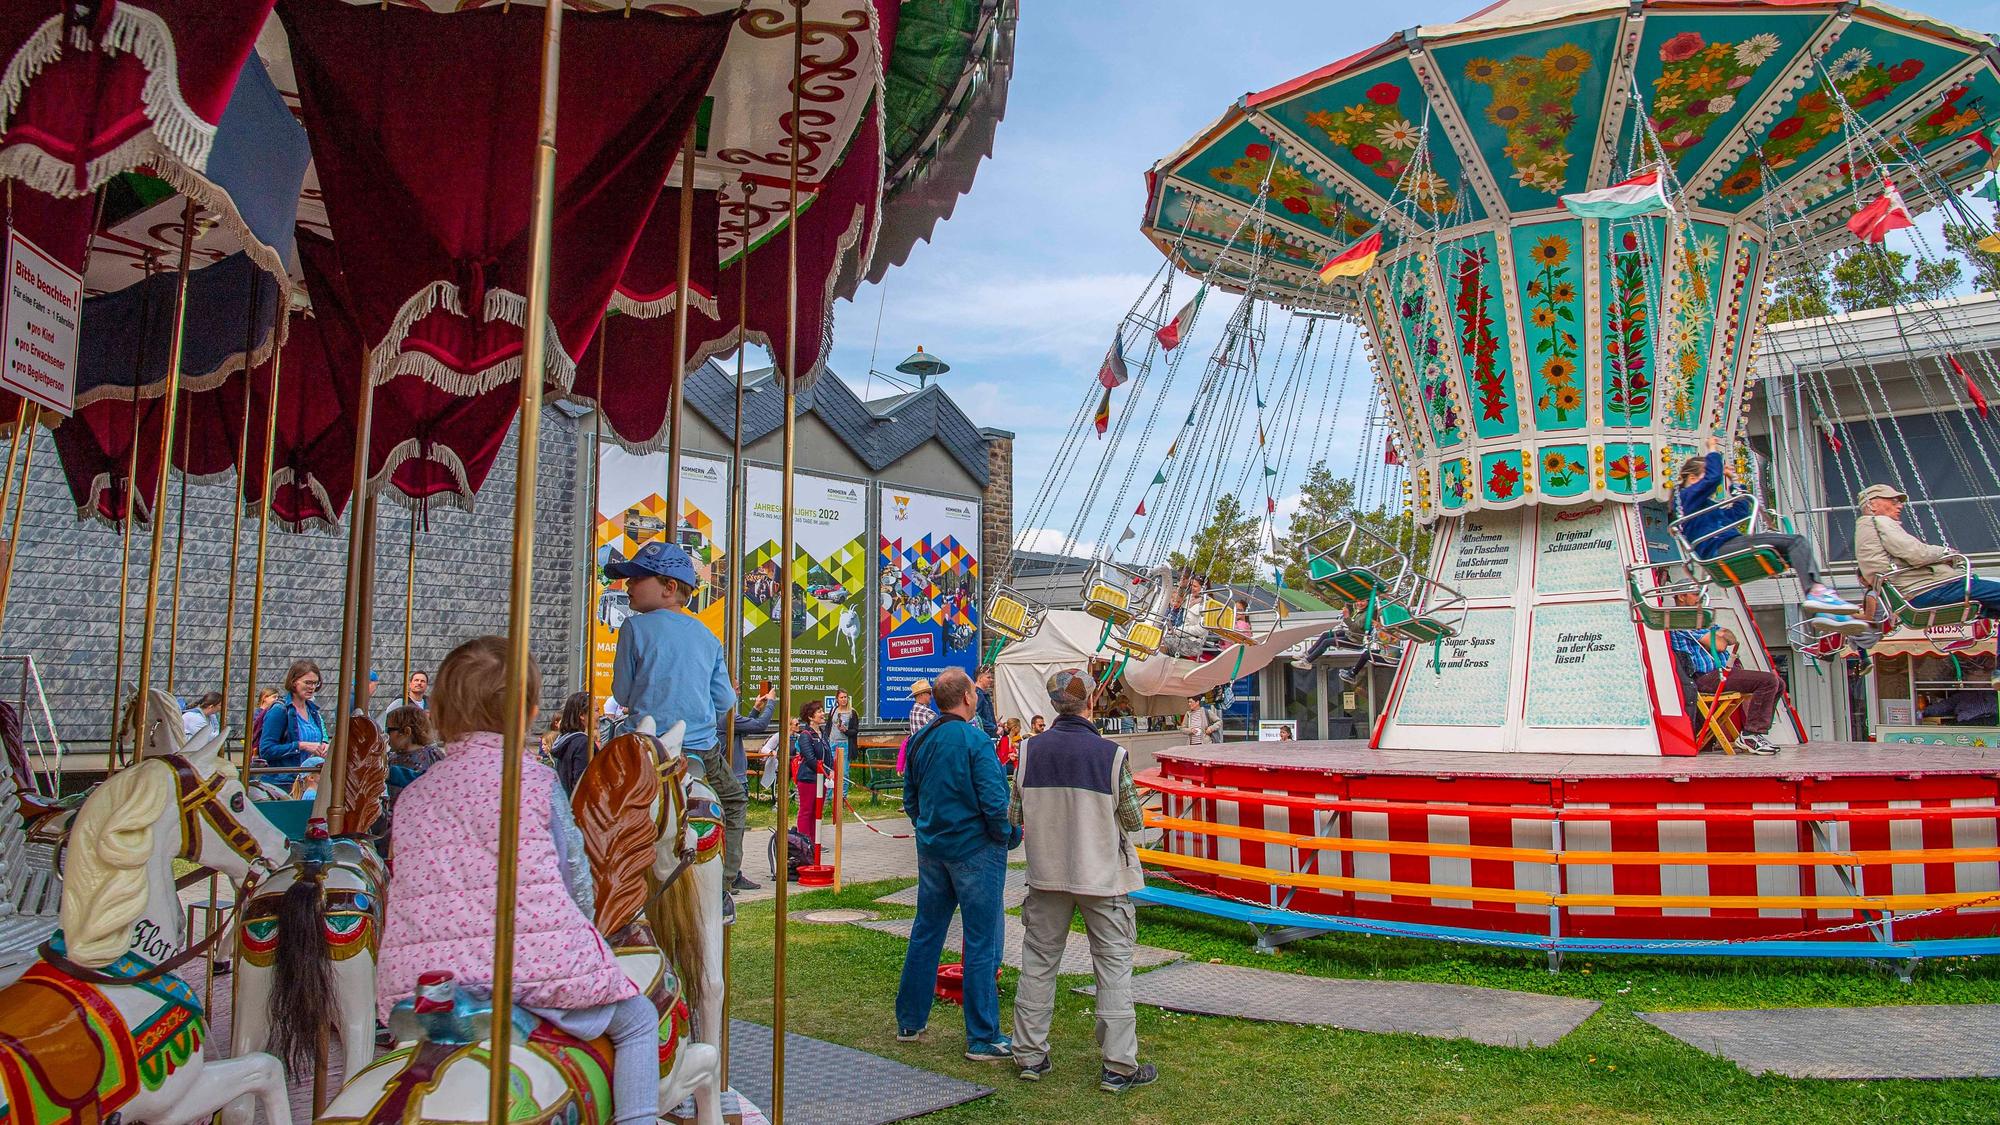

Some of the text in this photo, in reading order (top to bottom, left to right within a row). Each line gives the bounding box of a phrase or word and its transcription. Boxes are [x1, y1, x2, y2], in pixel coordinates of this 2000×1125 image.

[15, 259, 36, 286] Bitte
[36, 273, 72, 309] beachten
[31, 323, 55, 344] pro Kind
[19, 339, 66, 371] pro Erwachsener
[16, 361, 65, 392] pro Begleitperson
[818, 508, 839, 521] 2022
[1468, 523, 1483, 532] Das
[1460, 533, 1503, 543] Mitnehmen
[1555, 528, 1593, 542] Original
[1473, 544, 1510, 554] Flaschen
[1471, 557, 1508, 567] Schirmen
[1465, 568, 1502, 578] Verboten
[1444, 636, 1496, 648] Super-Spass
[1557, 632, 1603, 643] Fahrchips
[597, 642, 617, 652] MAR
[891, 639, 920, 648] MITMACHEN
[1570, 643, 1586, 652] der
[1586, 642, 1616, 652] Kasse
[900, 647, 924, 655] ERLEBEN!
[1425, 659, 1489, 668] Klin und Gross
[1554, 653, 1586, 664] lösen!
[790, 666, 814, 674] EITBLENDE
